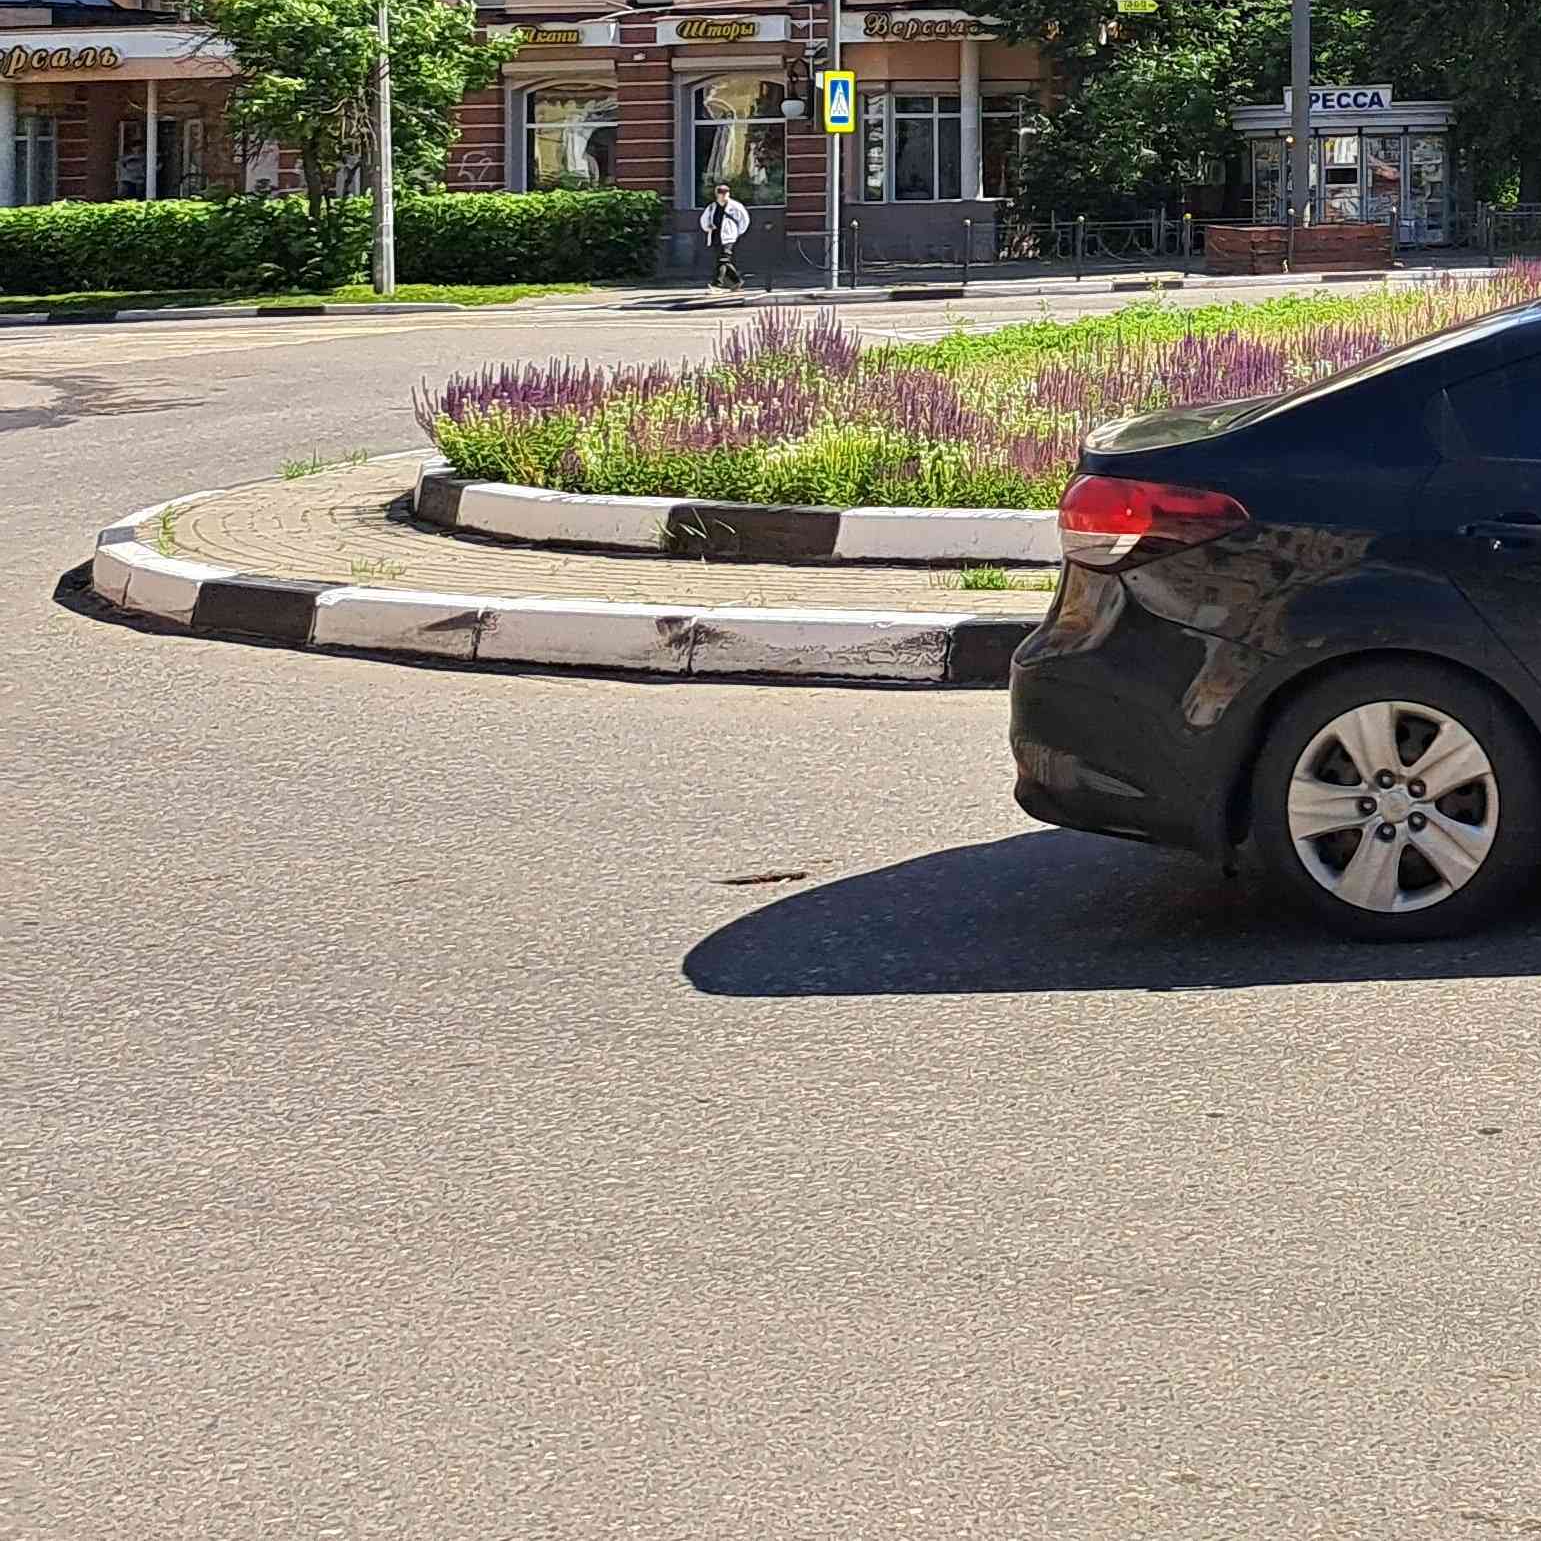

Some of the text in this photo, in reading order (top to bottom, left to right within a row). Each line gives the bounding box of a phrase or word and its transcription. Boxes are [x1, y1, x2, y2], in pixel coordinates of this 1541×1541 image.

[678, 19, 755, 41] Шторы
[0, 44, 121, 78] рсаль
[1309, 91, 1385, 109] РЕССА
